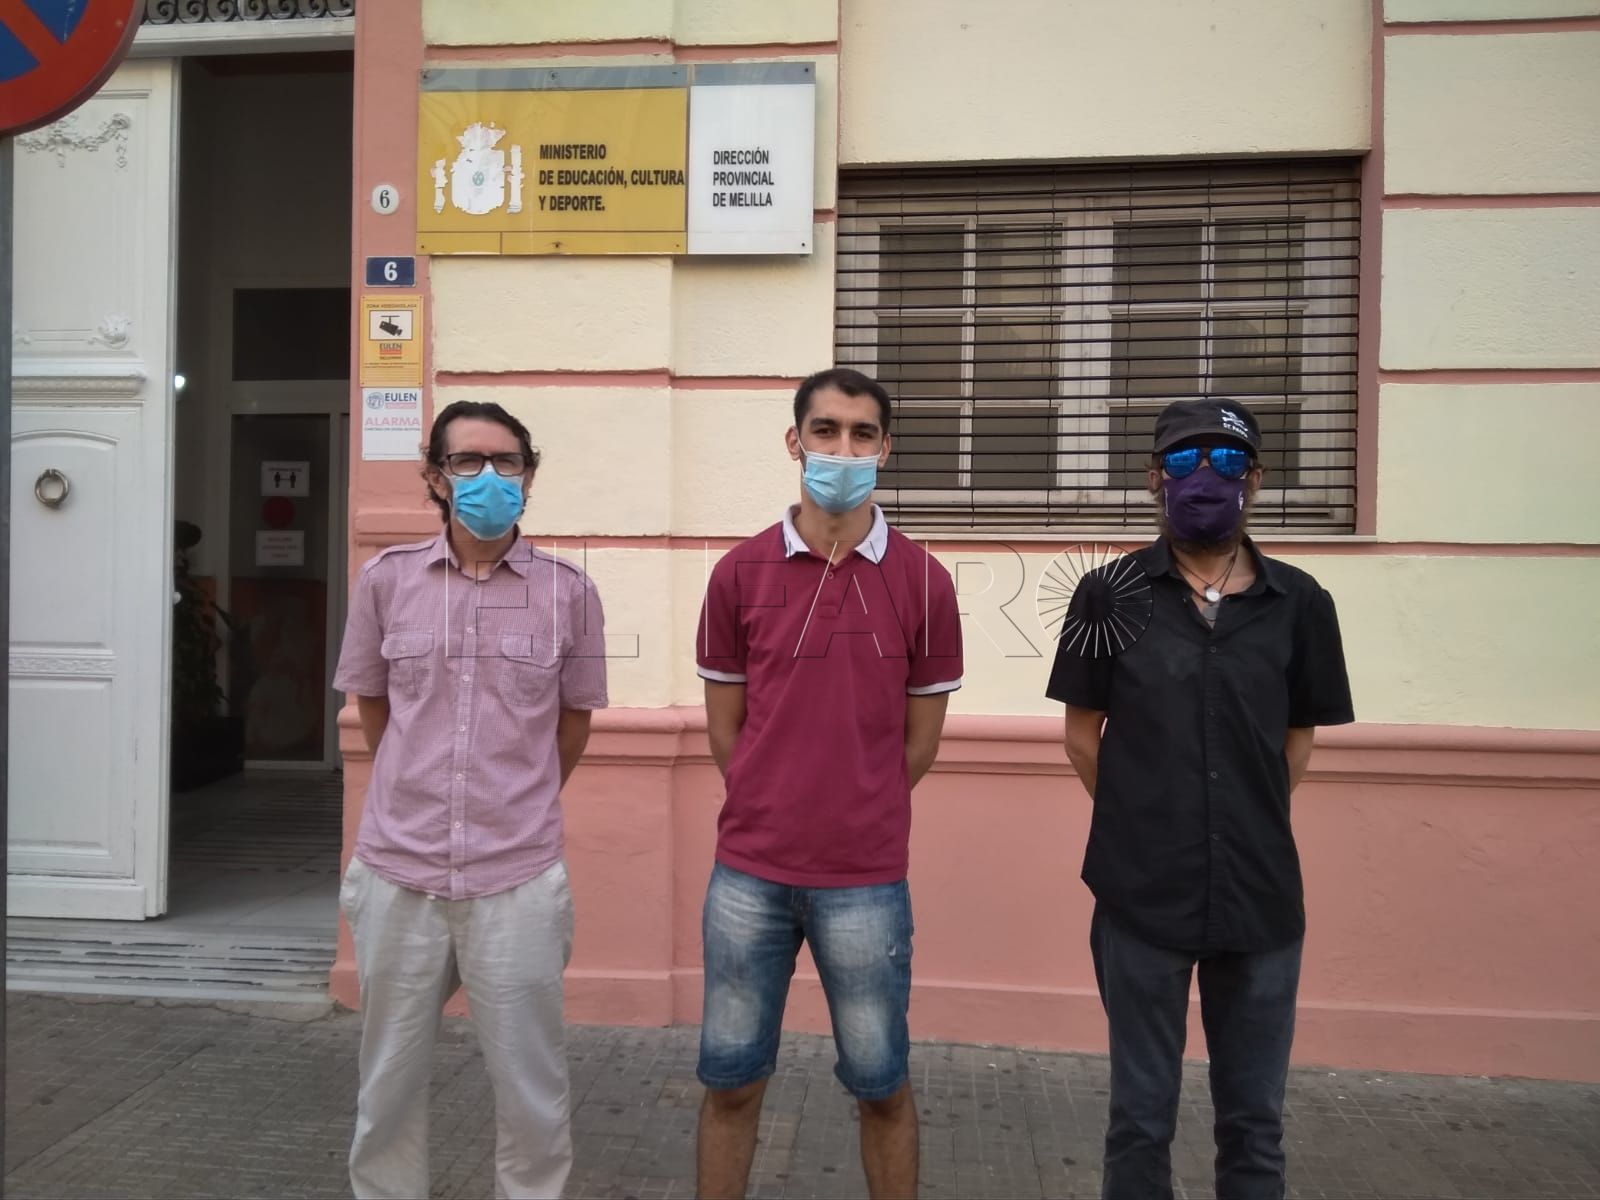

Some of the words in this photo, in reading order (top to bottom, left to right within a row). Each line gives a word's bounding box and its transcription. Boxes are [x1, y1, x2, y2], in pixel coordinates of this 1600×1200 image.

[539, 144, 607, 160] MINISTERIO
[713, 146, 769, 165] DIRECCIÓN
[539, 170, 554, 185] DE
[557, 166, 628, 189] EDUCACIÓN,
[630, 170, 685, 185] CULTURA
[713, 171, 775, 186] PROVINCIAL
[379, 189, 391, 209] 6
[538, 195, 547, 211] Y
[549, 195, 606, 211] DEPORTE.
[712, 192, 727, 207] DE
[729, 191, 773, 207] MELILLA
[383, 261, 399, 282] 6
[384, 392, 418, 402] EULEN
[365, 417, 421, 427] ALARMA
